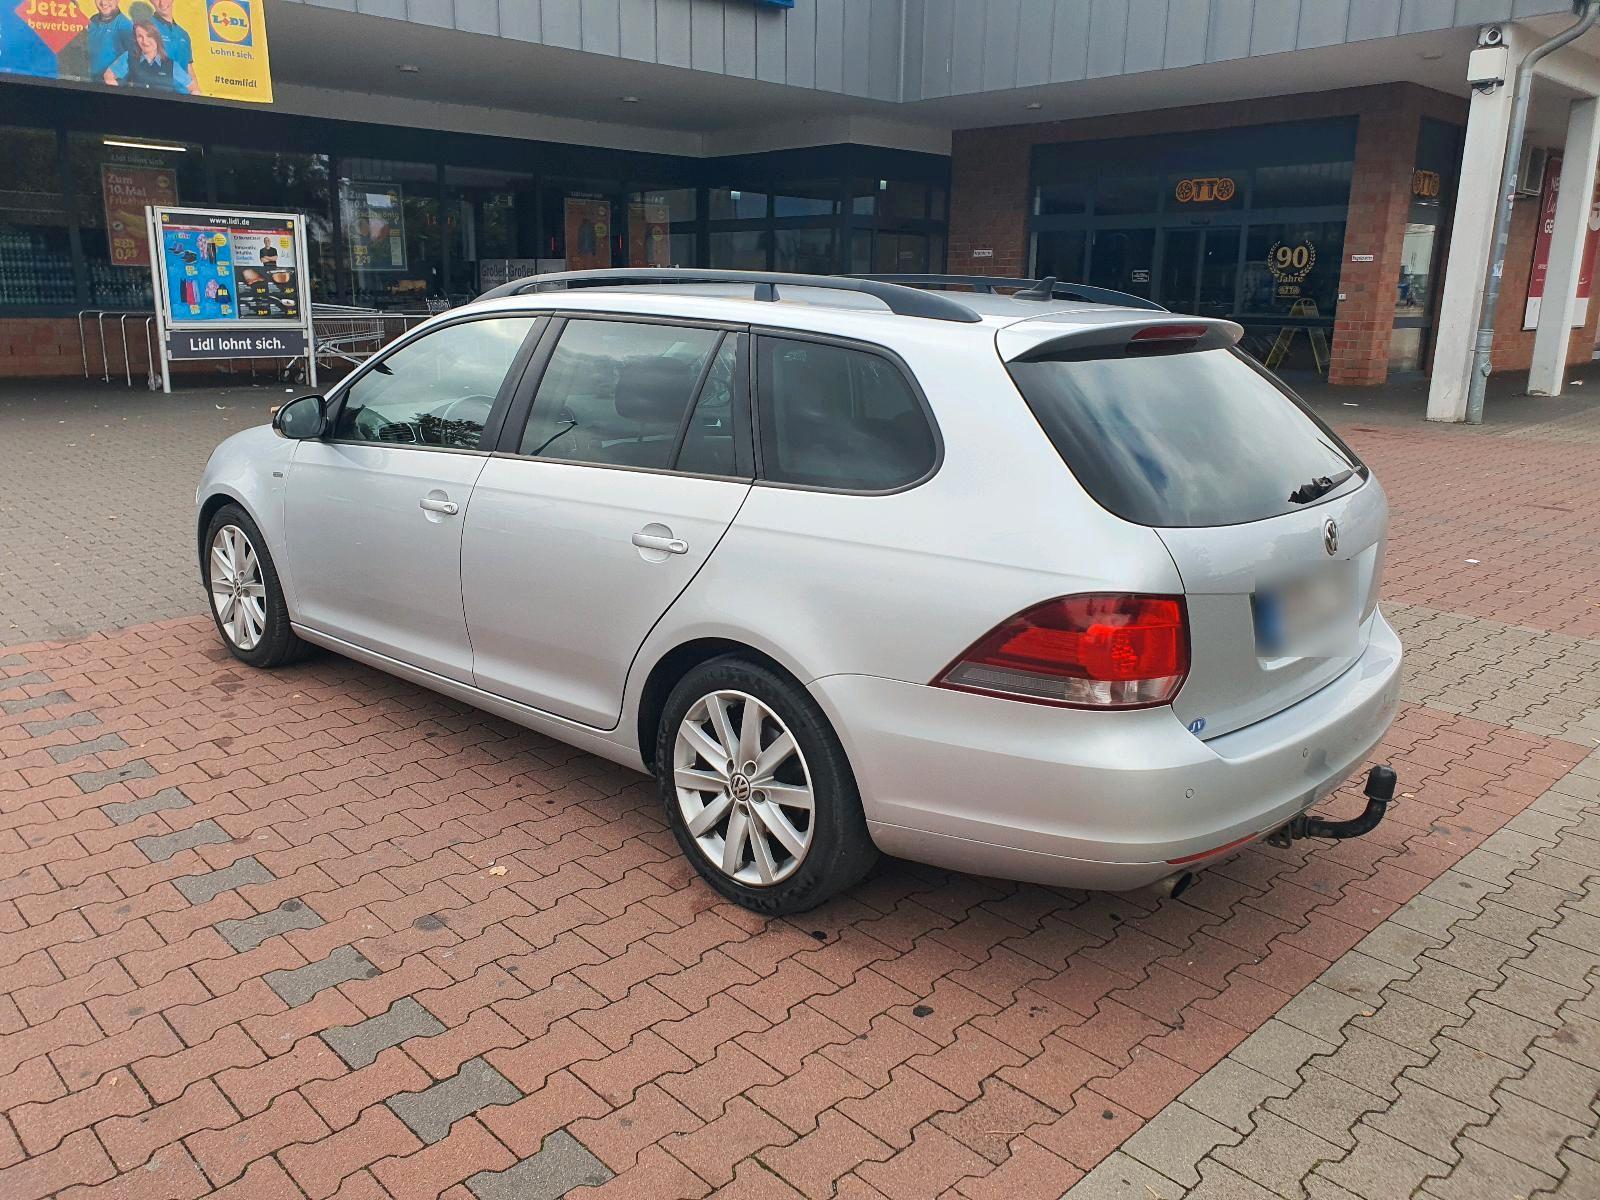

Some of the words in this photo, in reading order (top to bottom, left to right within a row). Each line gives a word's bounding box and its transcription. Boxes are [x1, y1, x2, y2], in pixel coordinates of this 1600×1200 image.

[25, 0, 78, 18] Jetzt
[27, 18, 84, 32] bewerben
[215, 75, 257, 88] #teamlidl
[1176, 178, 1235, 202] OTTO
[209, 217, 250, 226] www.lidl.de
[1276, 245, 1309, 268] 90
[1277, 273, 1304, 283] Jahre
[190, 337, 214, 351] Lidl
[218, 337, 252, 350] lohnt
[255, 336, 286, 350] sich.
